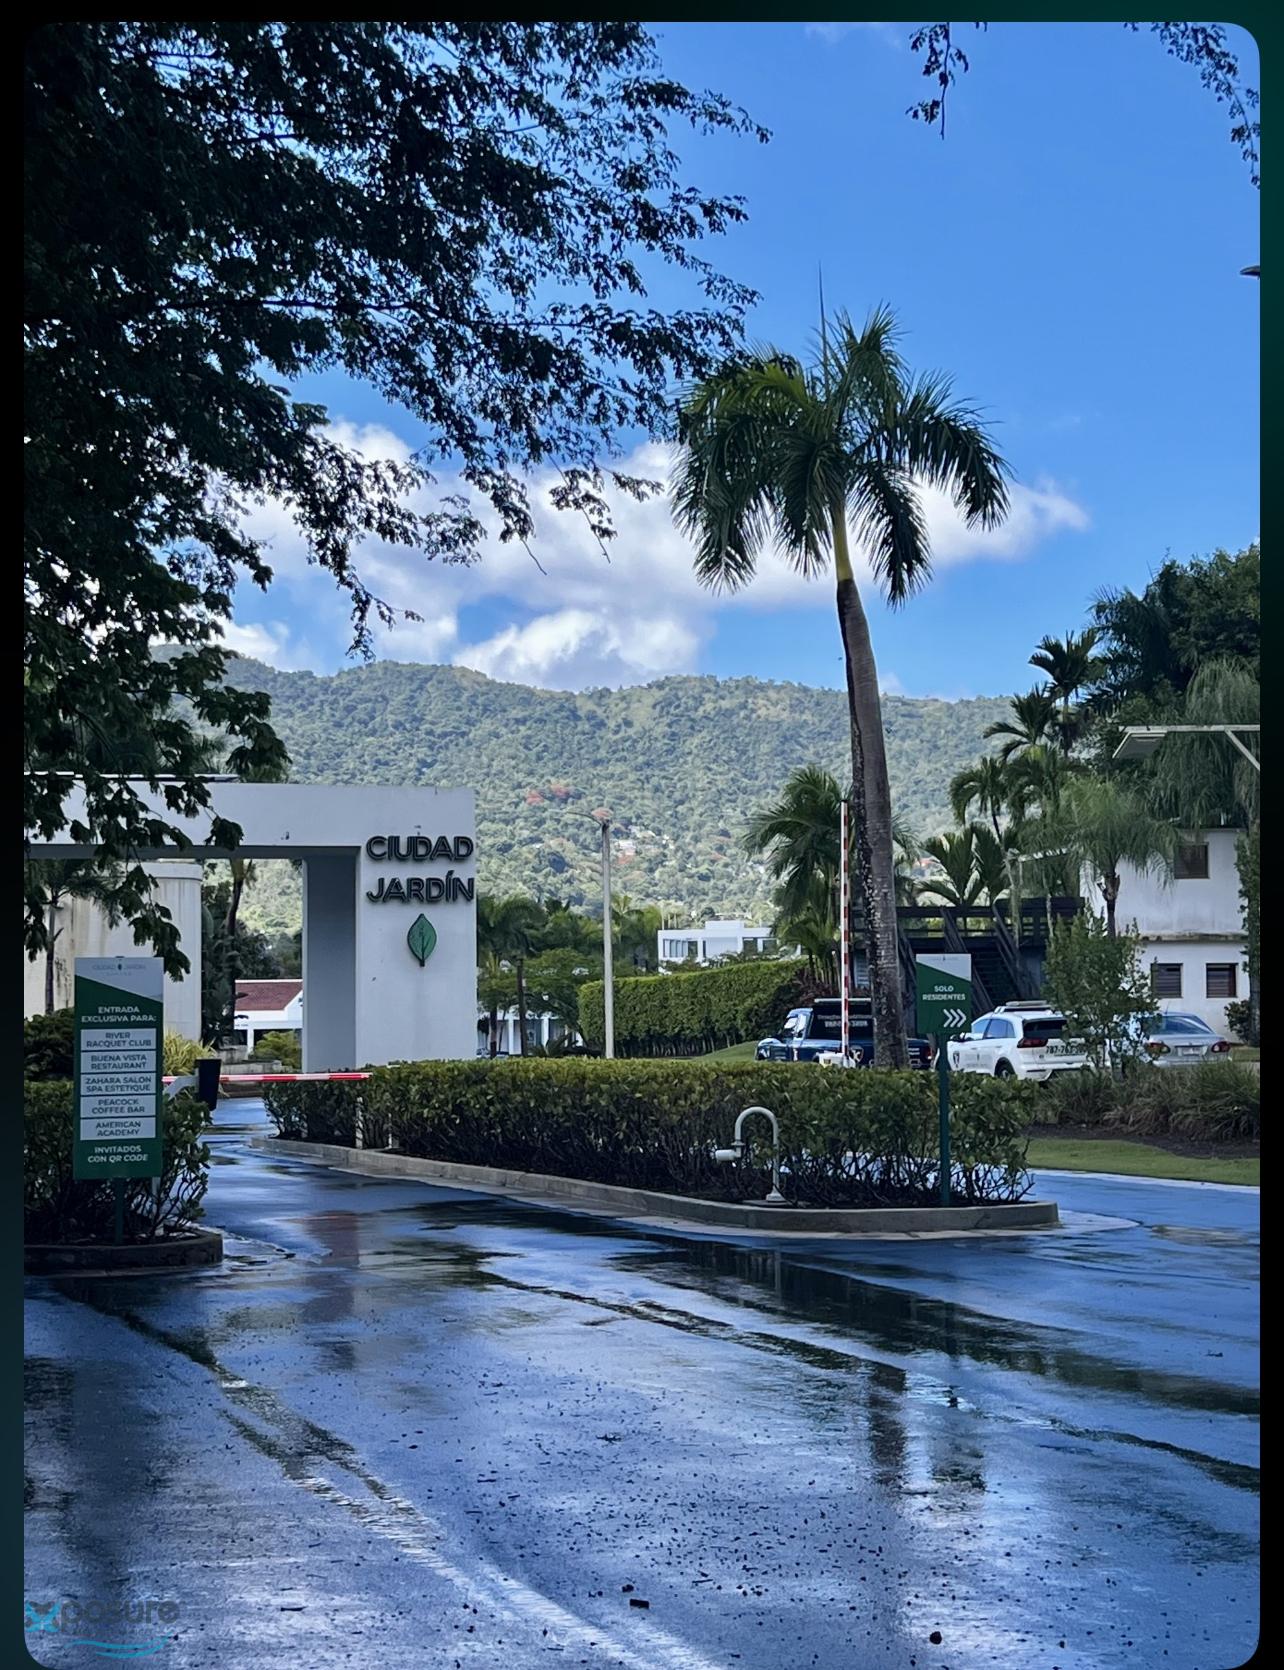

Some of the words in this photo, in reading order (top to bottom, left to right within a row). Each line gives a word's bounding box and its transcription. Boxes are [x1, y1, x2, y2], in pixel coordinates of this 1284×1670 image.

[366, 835, 474, 862] CIUDAD
[366, 870, 475, 904] JARDÍN
[922, 992, 966, 1000] RESIDENTES
[98, 1006, 140, 1014] ENTRADA
[81, 1015, 128, 1023] EXCLUSIVA
[130, 1014, 157, 1022] PARA:
[105, 1031, 131, 1039] RIVER
[86, 1040, 127, 1048] RACQUET
[90, 1054, 121, 1062] BUENA
[91, 1062, 147, 1070] RESTAURANT
[86, 1076, 122, 1084] ZAHARA
[105, 1084, 151, 1092] ESTETIQUE
[98, 1098, 139, 1106] PEACOCK
[91, 1106, 126, 1114] COFFEE
[96, 1121, 141, 1129] AMERICAN
[97, 1129, 140, 1137] ACADEMY
[94, 1144, 142, 1154] INVITADOS
[87, 1155, 107, 1163] CON
[108, 1155, 123, 1163] QR
[123, 1153, 149, 1162] CODE
